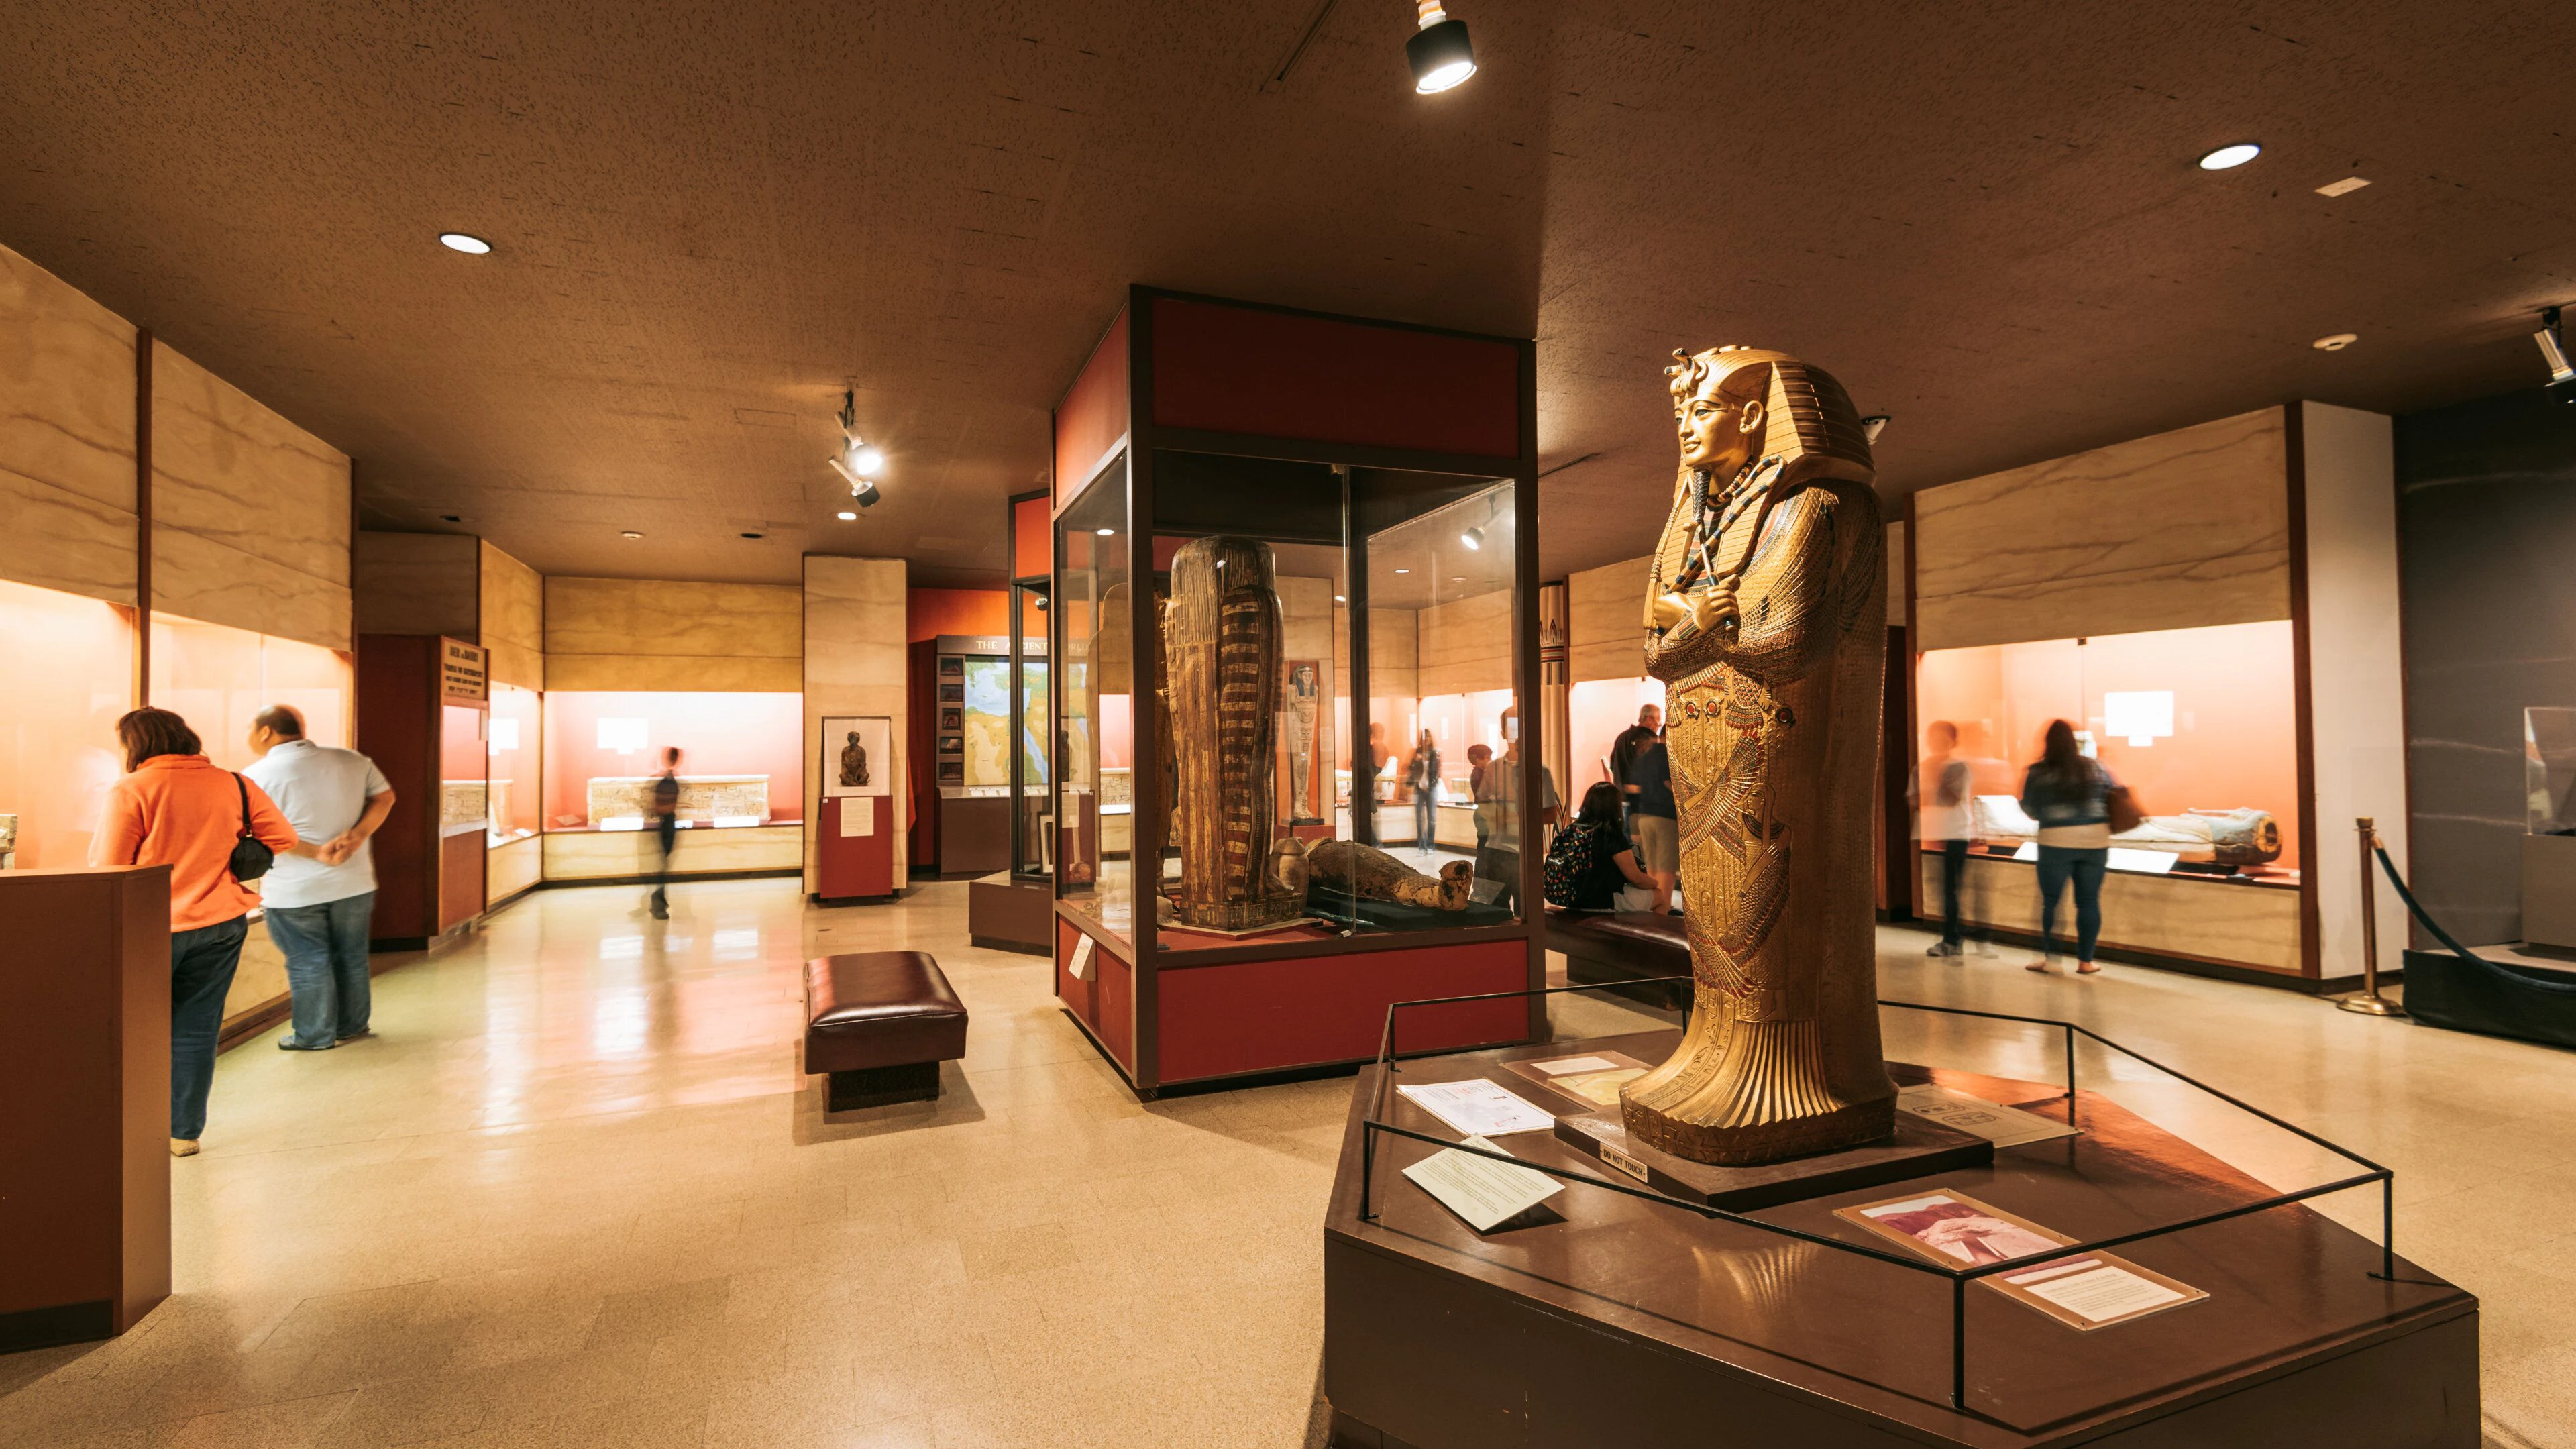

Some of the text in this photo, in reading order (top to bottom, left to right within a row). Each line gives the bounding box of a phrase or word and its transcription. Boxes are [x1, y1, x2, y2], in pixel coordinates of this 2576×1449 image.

[976, 641, 998, 649] THE
[1603, 1149, 1642, 1176] DO NOT TOUCH
